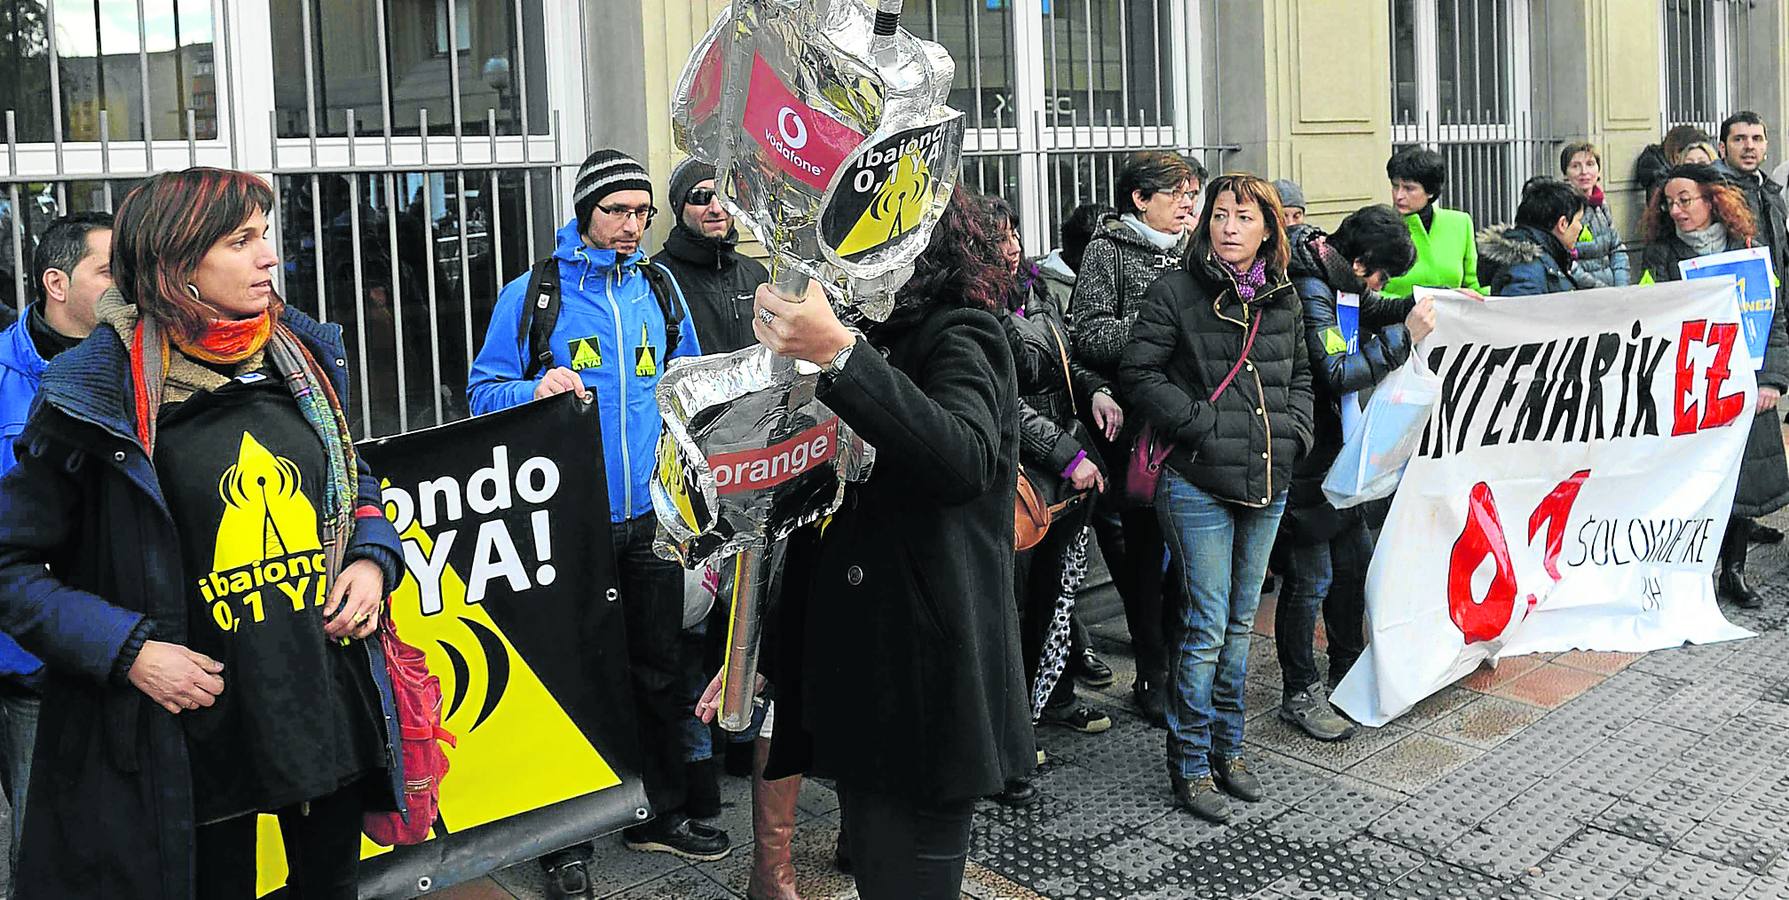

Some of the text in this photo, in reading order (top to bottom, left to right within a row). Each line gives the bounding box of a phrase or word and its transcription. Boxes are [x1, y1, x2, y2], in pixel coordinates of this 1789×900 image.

[764, 128, 822, 176] vodafone
[1670, 318, 1746, 437] EZ
[713, 433, 829, 488] orange
[401, 509, 557, 616] YA!
[211, 590, 266, 633] 0,1
